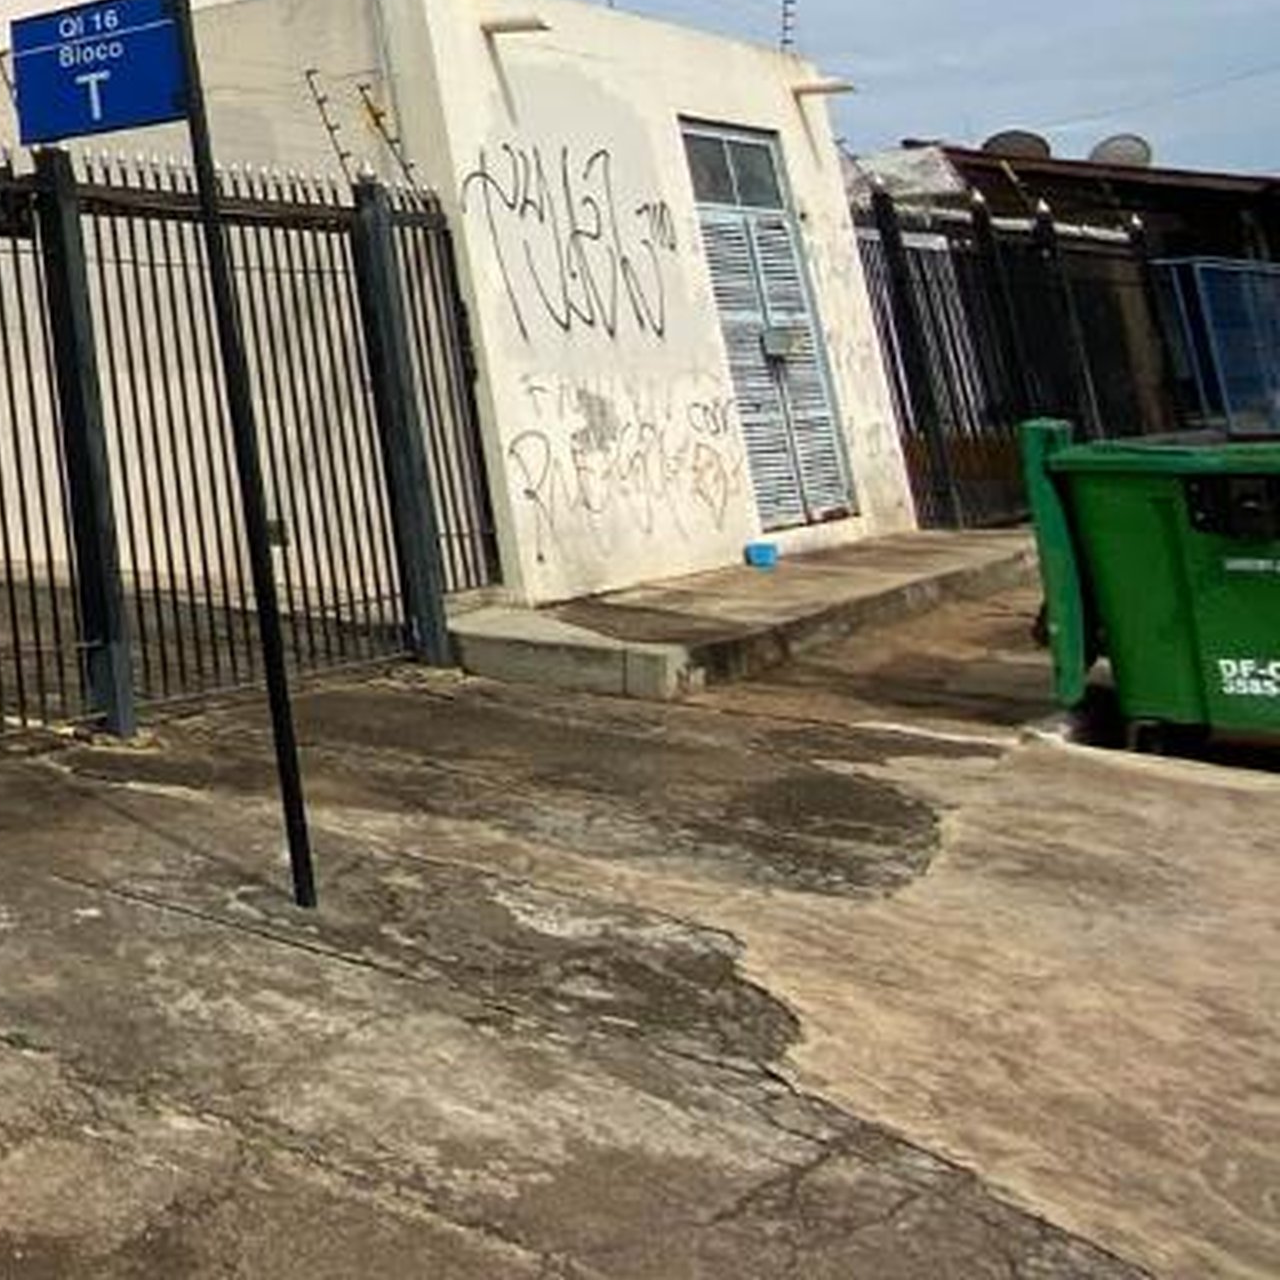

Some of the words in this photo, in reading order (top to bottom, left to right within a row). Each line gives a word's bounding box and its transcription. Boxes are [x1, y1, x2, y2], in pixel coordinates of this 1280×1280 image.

[58, 17, 85, 38] QI
[93, 9, 119, 30] 16
[58, 41, 125, 68] Bloco
[74, 70, 112, 121] T
